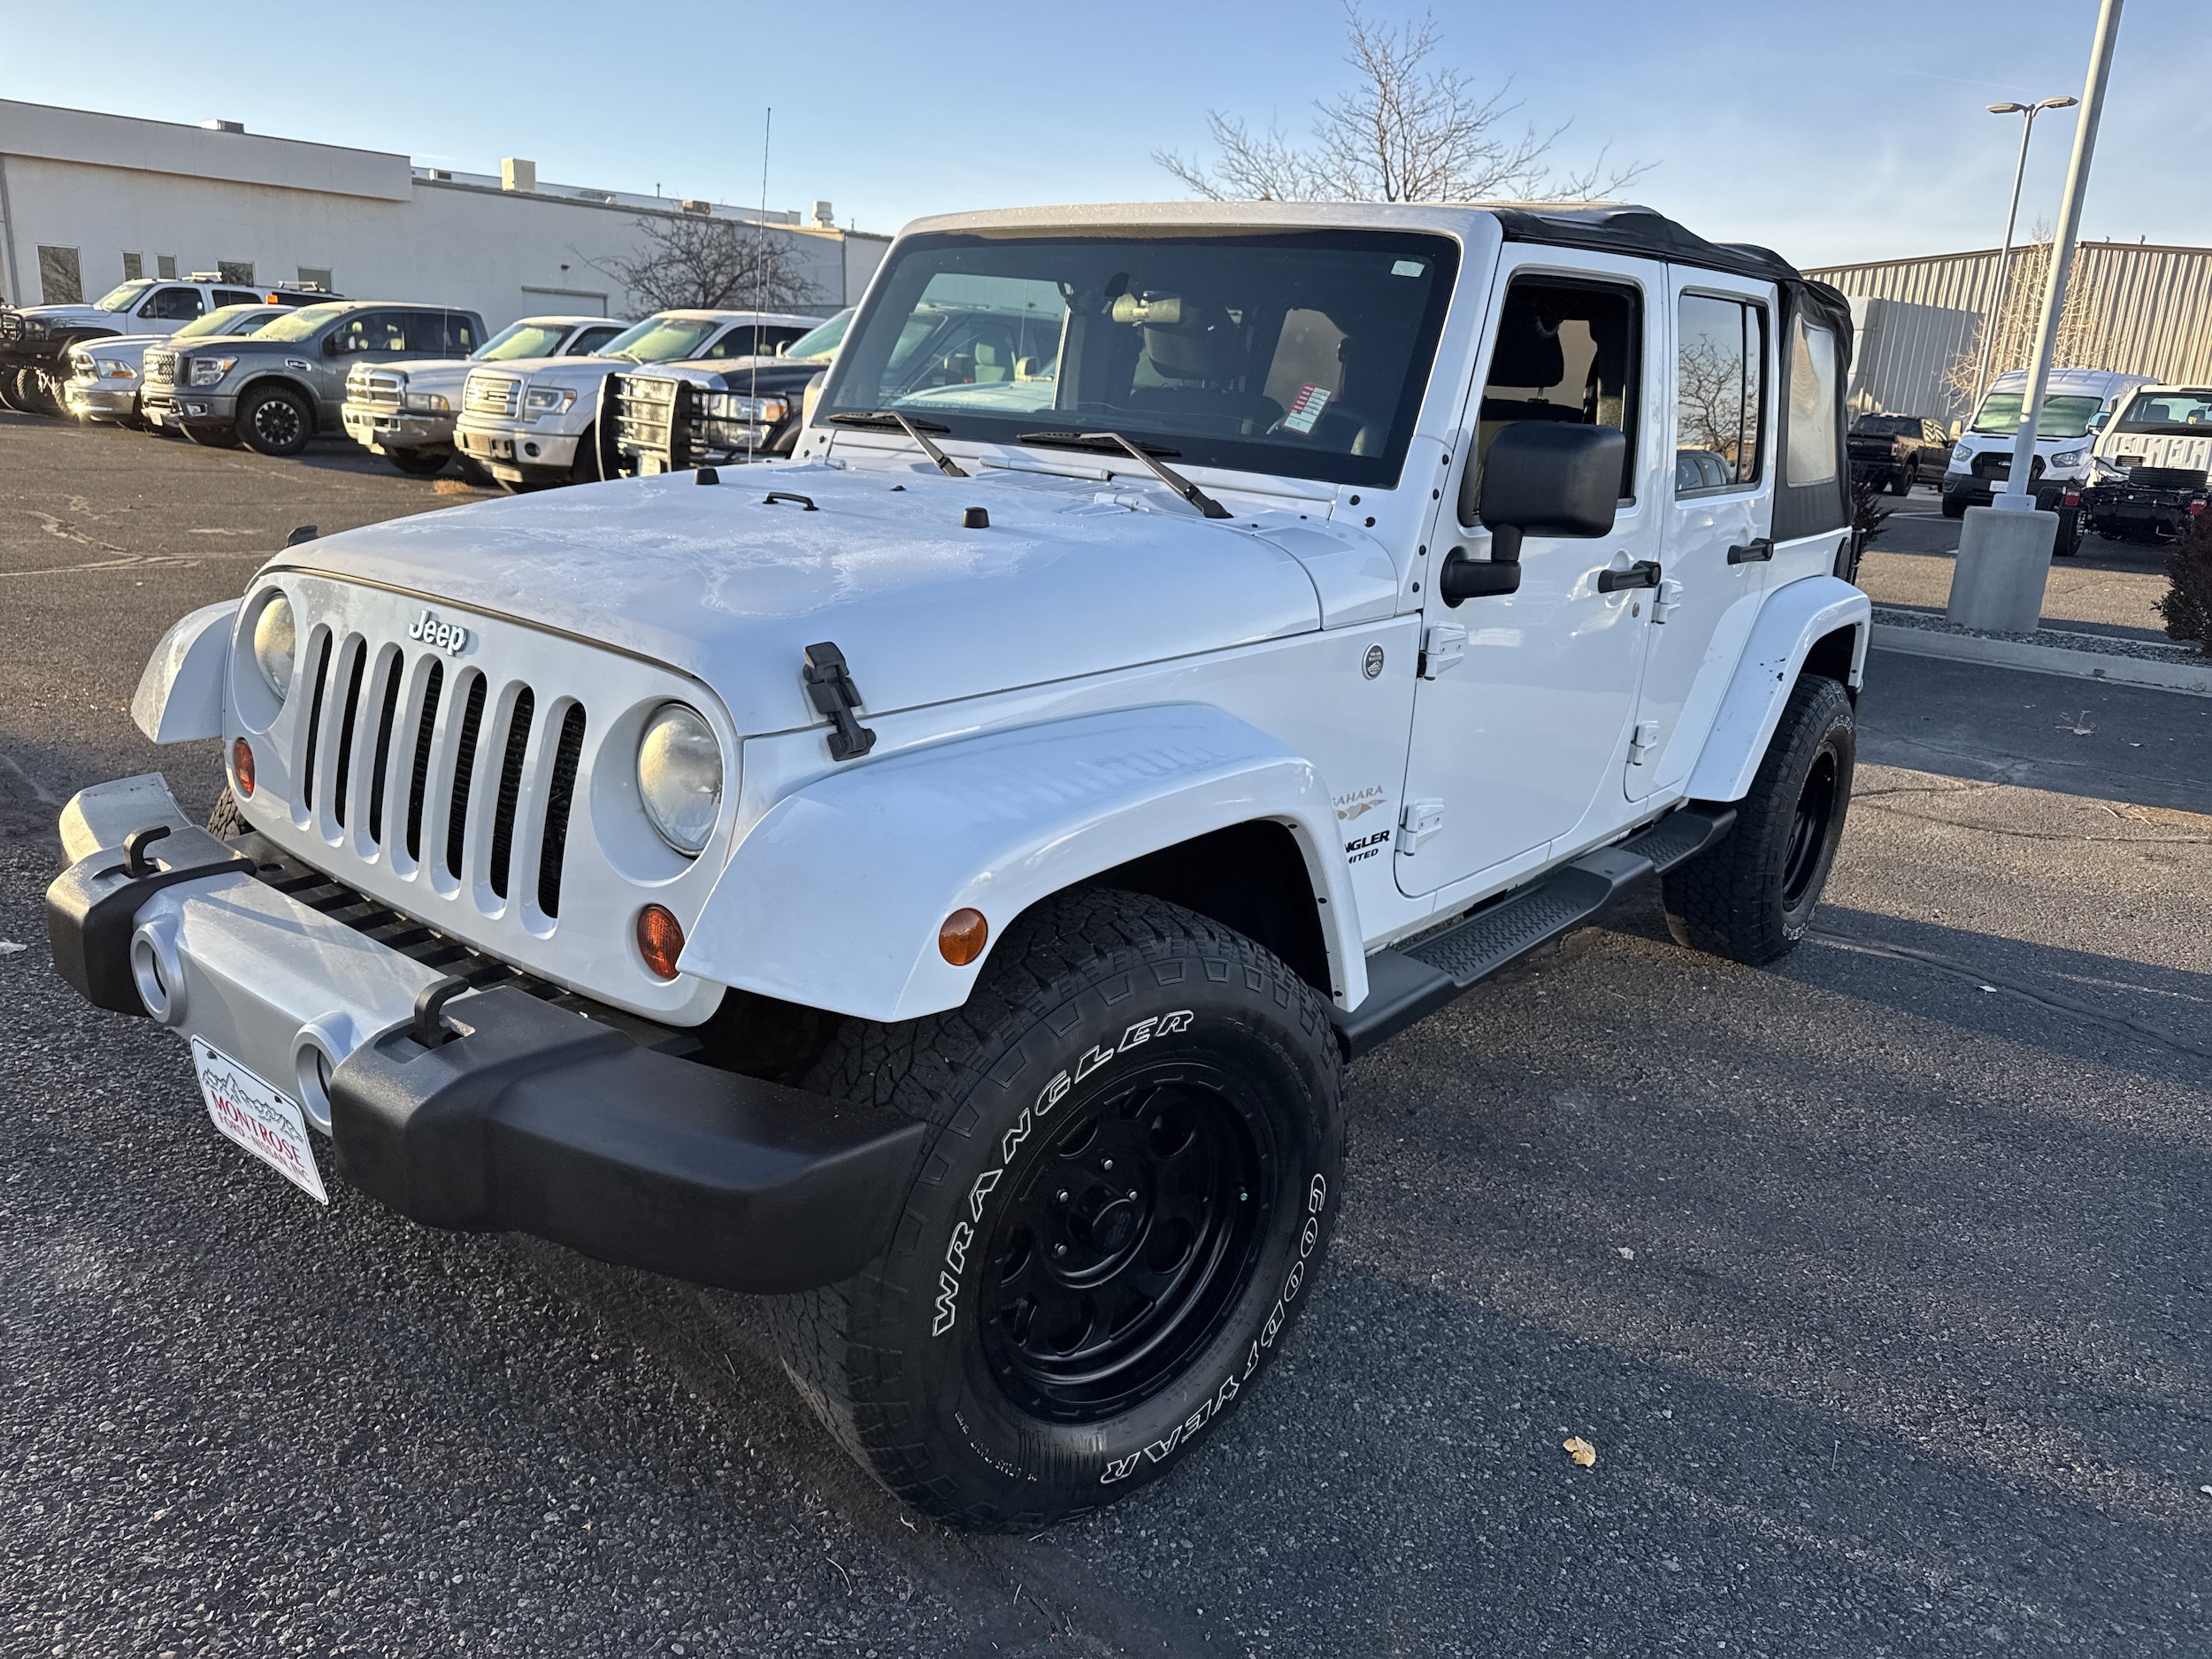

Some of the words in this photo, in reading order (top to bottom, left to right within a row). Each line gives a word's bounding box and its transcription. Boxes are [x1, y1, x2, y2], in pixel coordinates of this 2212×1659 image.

[409, 609, 468, 657] Jeep
[211, 1089, 305, 1168] MONTROSE
[218, 1111, 245, 1138] FORD
[932, 1010, 1194, 1337] WRANGLER
[1100, 1173, 1326, 1484] GOODYEAR
